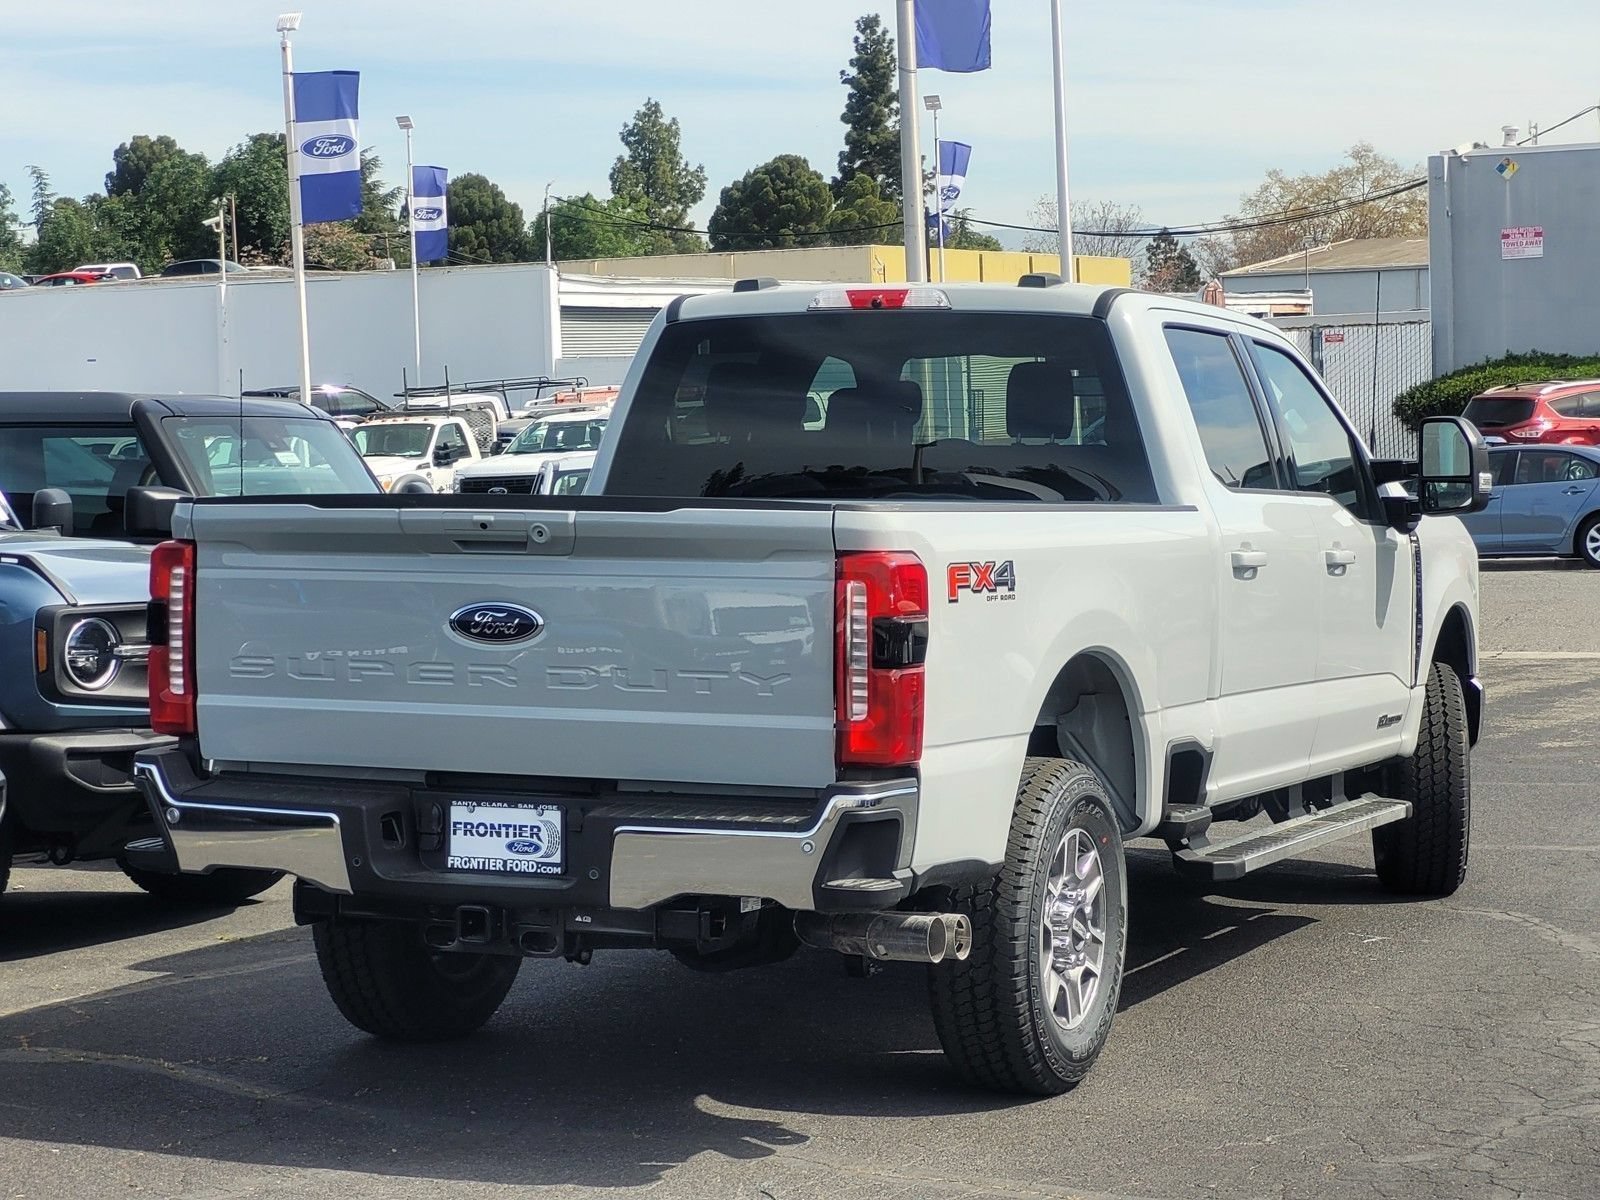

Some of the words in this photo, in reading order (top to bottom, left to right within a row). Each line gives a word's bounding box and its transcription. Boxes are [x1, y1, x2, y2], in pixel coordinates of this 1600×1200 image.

[313, 138, 347, 156] Ford
[414, 209, 438, 221] Ford
[1525, 239, 1543, 247] AWAY
[947, 560, 1016, 603] FX4
[1000, 593, 1016, 601] ROAD
[470, 610, 519, 635] Ford
[230, 656, 518, 687] SUPER
[546, 664, 792, 696] DUTY
[452, 821, 544, 844] FRONTIER
[511, 842, 535, 853] Ford
[447, 856, 504, 871] FRONTIER
